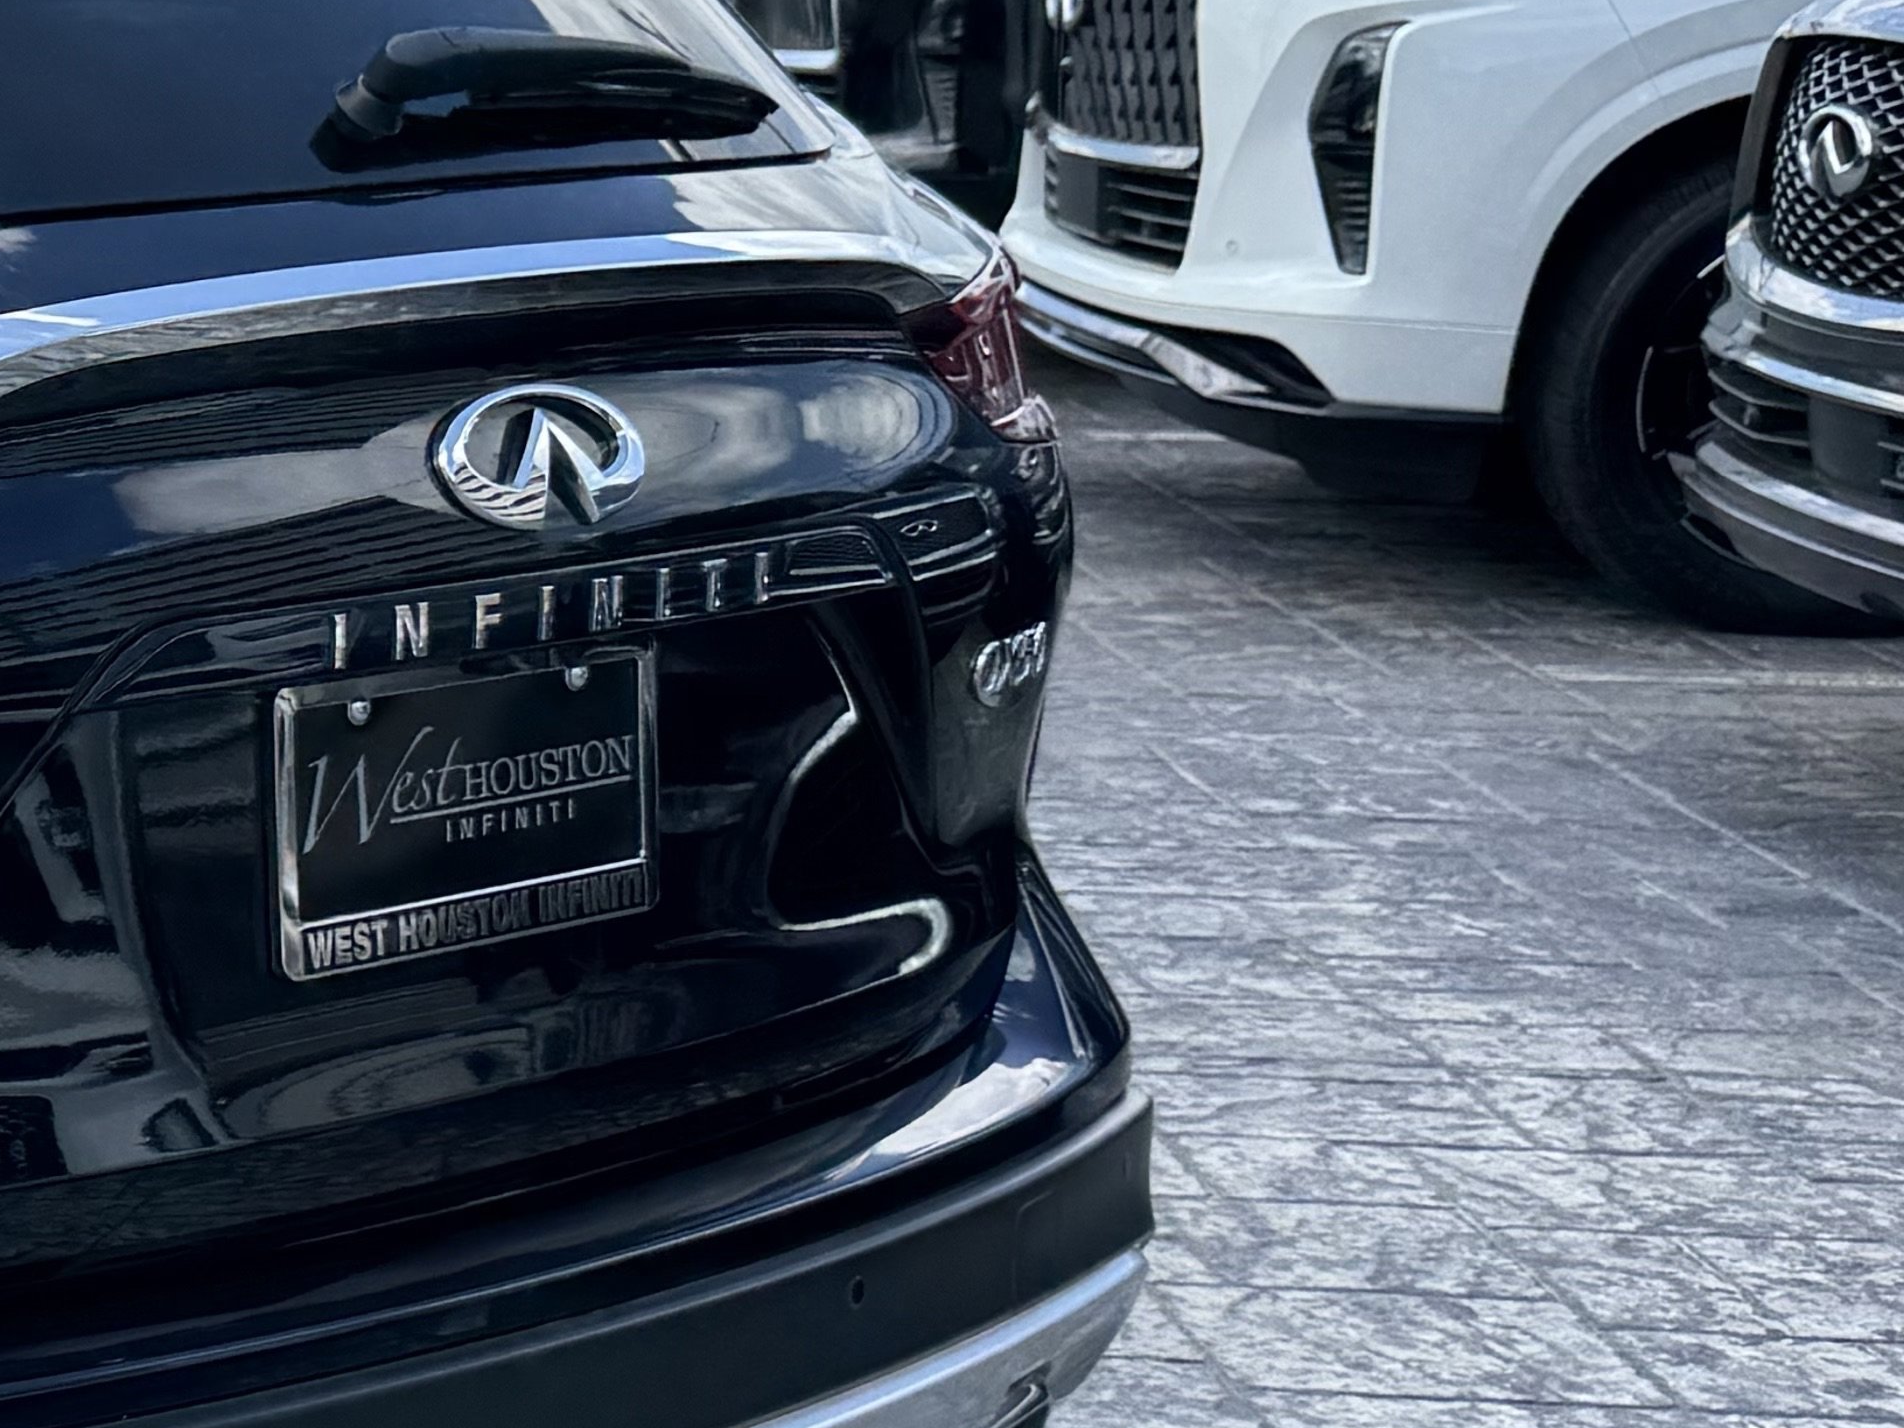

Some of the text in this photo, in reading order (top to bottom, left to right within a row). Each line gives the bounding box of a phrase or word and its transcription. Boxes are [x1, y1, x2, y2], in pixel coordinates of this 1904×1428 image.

[329, 551, 770, 670] INFINITI
[445, 797, 577, 843] INFINITI
[307, 866, 643, 970] WEST HOUSTON INFINITI
